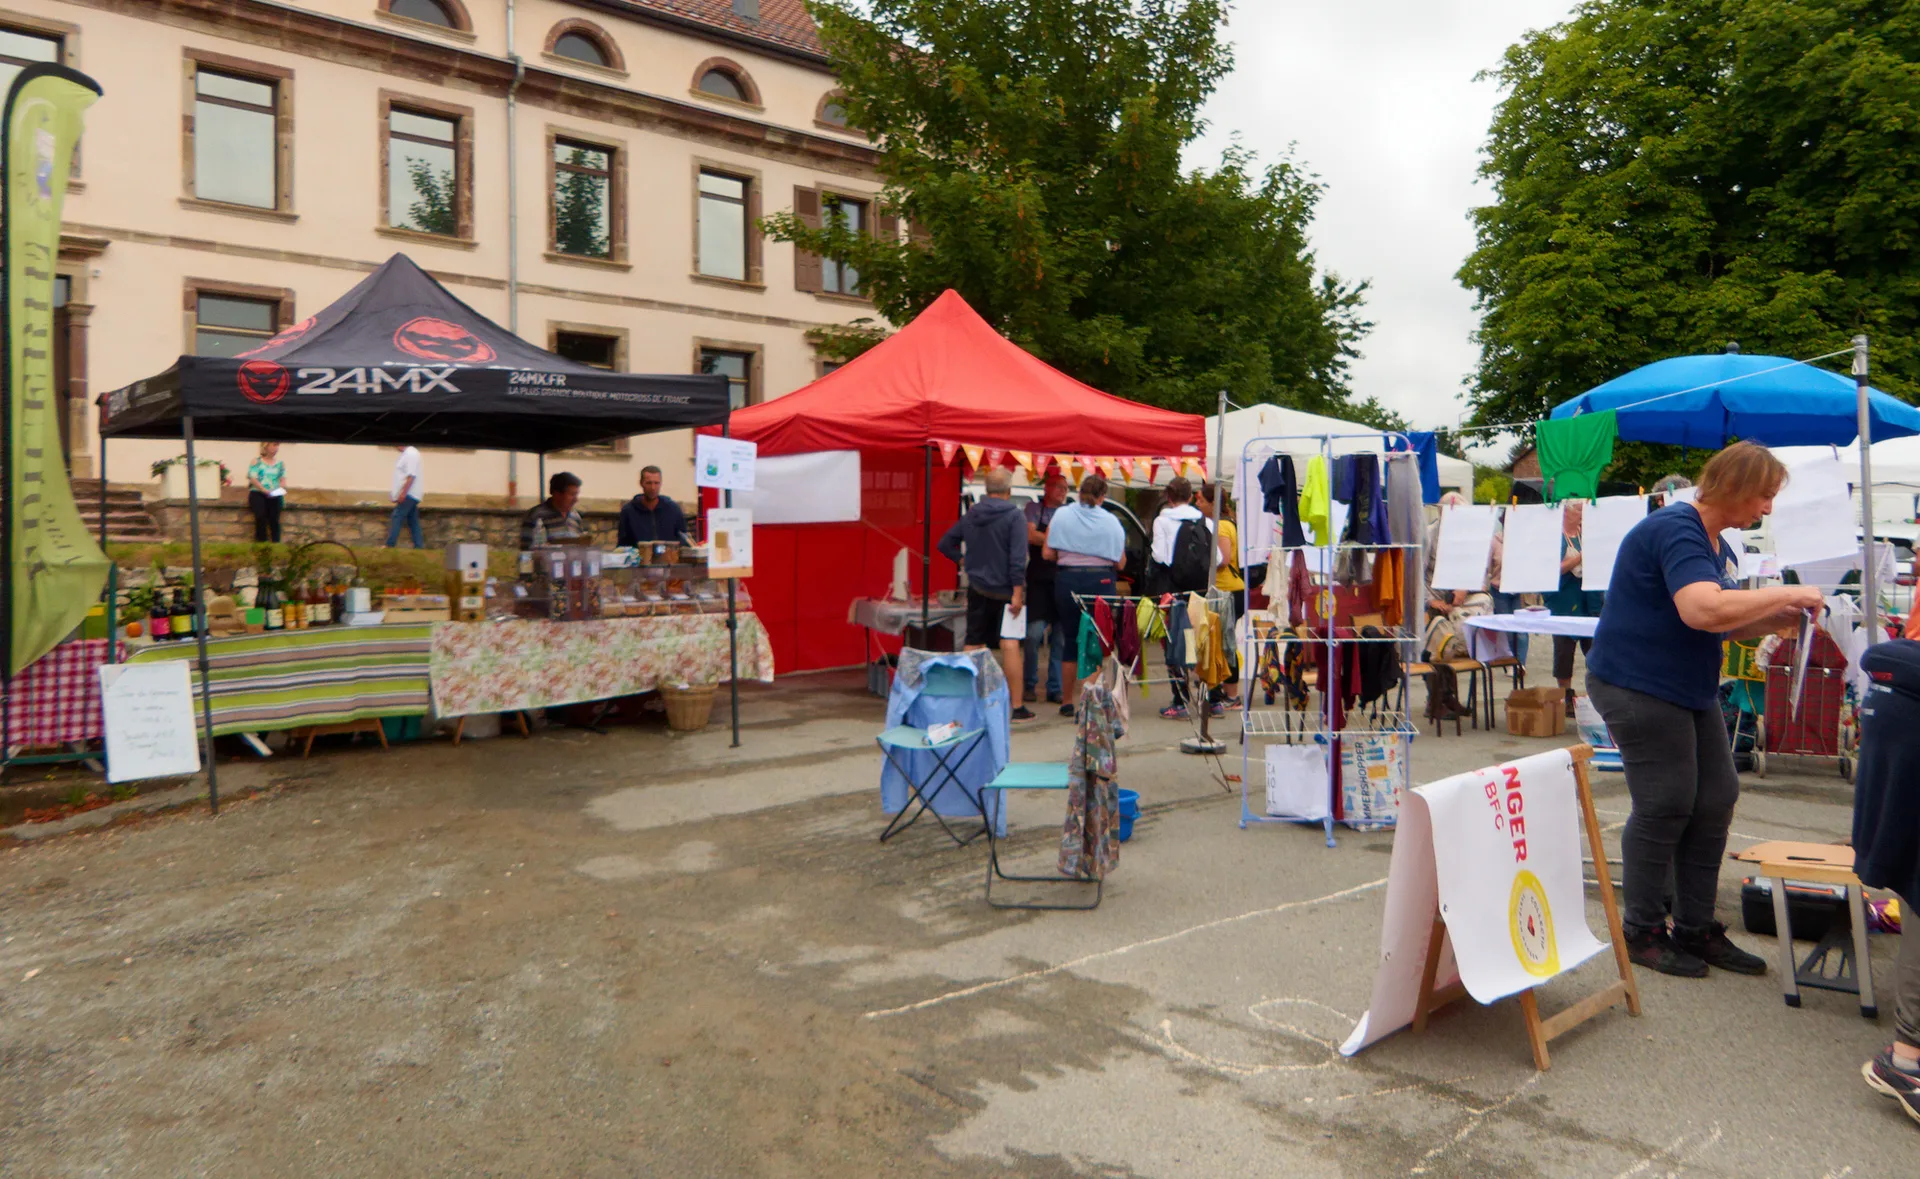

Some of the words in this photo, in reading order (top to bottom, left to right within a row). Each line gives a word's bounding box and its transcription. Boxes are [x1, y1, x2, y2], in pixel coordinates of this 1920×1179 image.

[296, 367, 462, 395] 24MX
[508, 386, 519, 395] LA
[520, 387, 539, 396] PLUS
[509, 371, 567, 386] 24MX.FR
[1484, 781, 1505, 831] BFC
[1498, 764, 1528, 863] NGER
